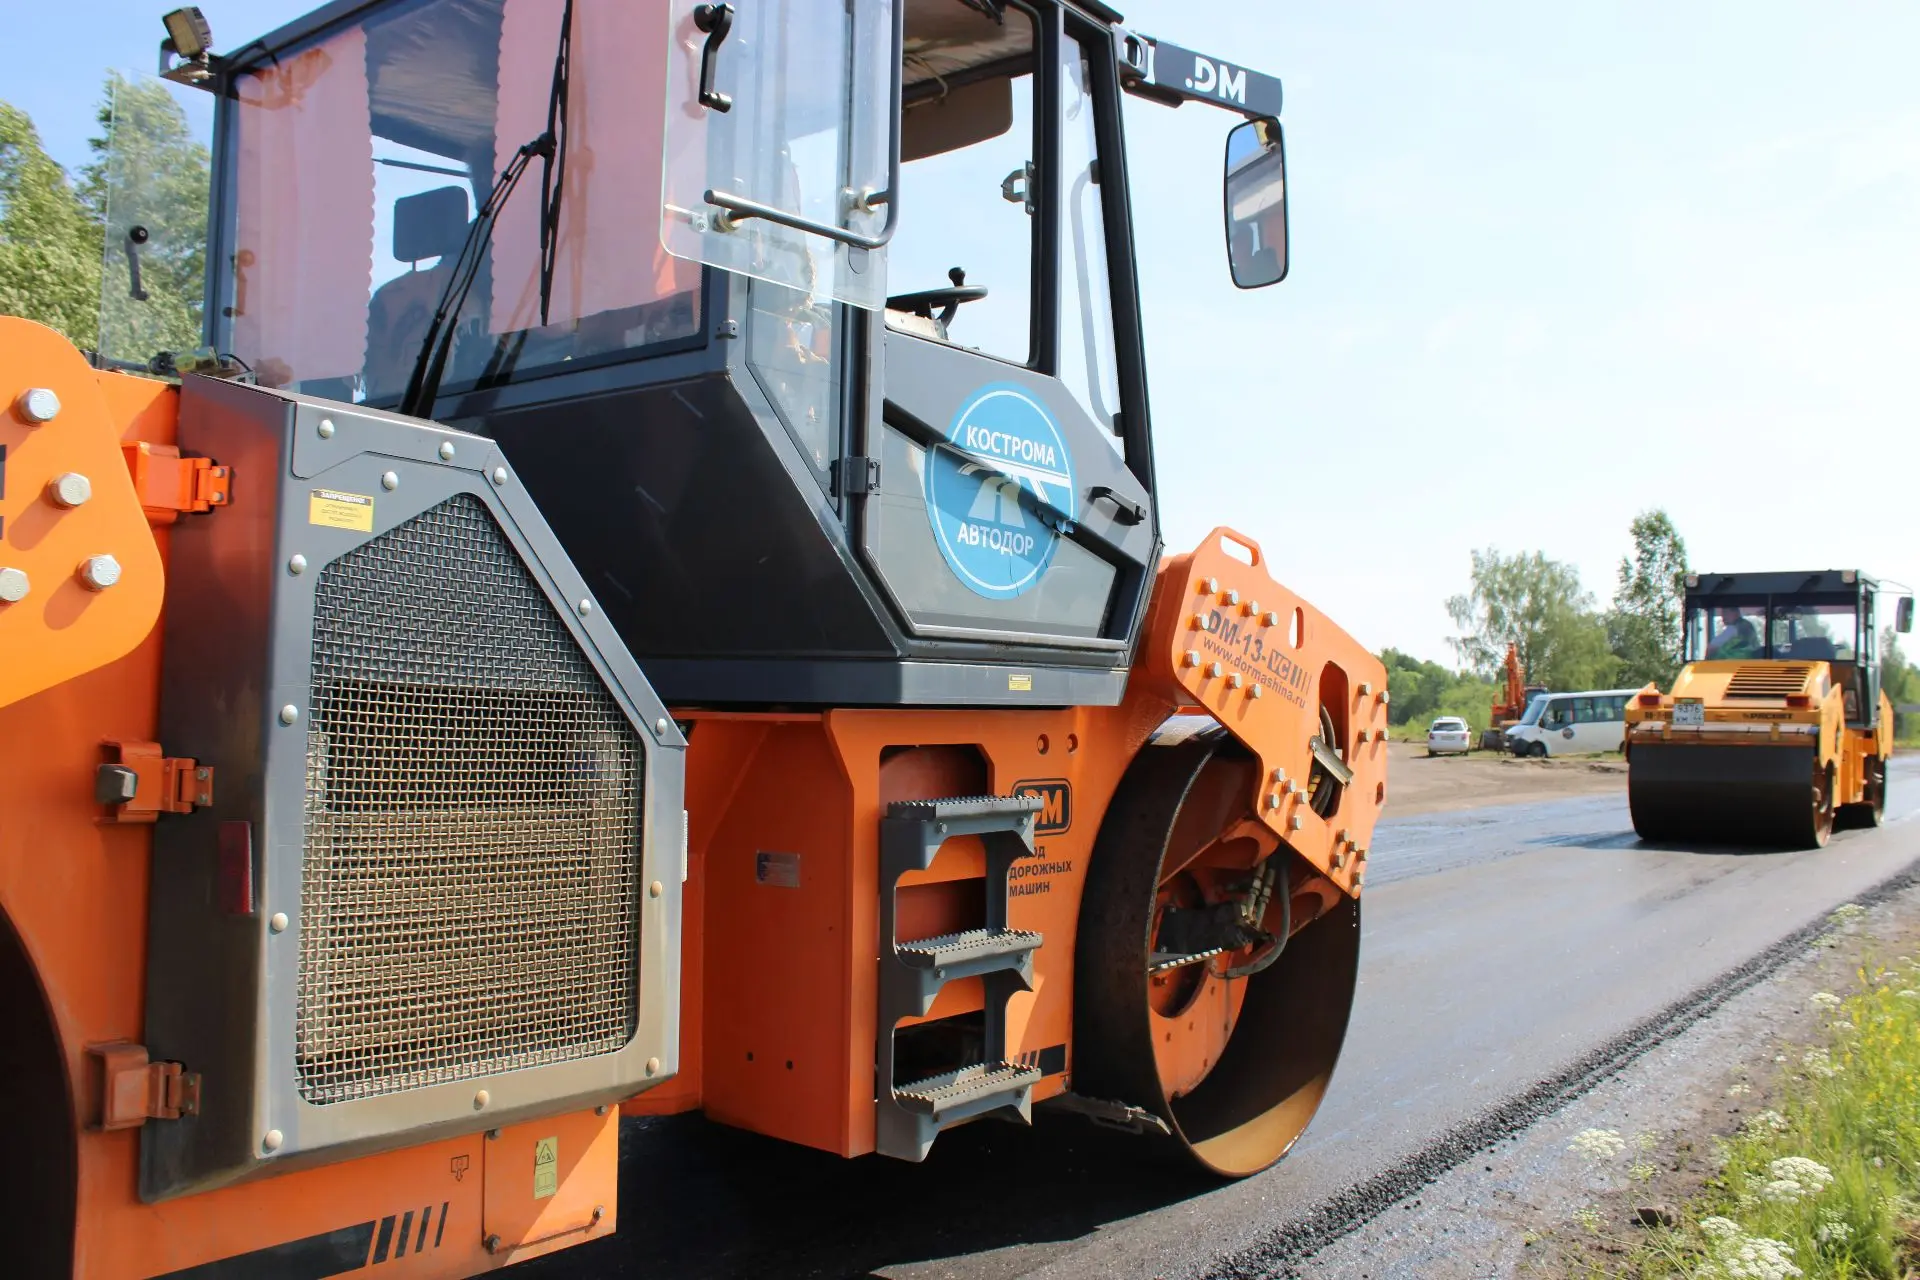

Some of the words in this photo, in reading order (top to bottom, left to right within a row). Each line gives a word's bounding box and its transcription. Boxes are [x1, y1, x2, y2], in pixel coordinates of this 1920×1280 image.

[966, 425, 1056, 467] КОСТРОМА
[957, 522, 1034, 556] АВТОДОР
[1203, 636, 1306, 709] www.dormashina.ru
[1008, 860, 1072, 881] ДОРОЖНЫХ
[1009, 881, 1051, 897] МАШИН
